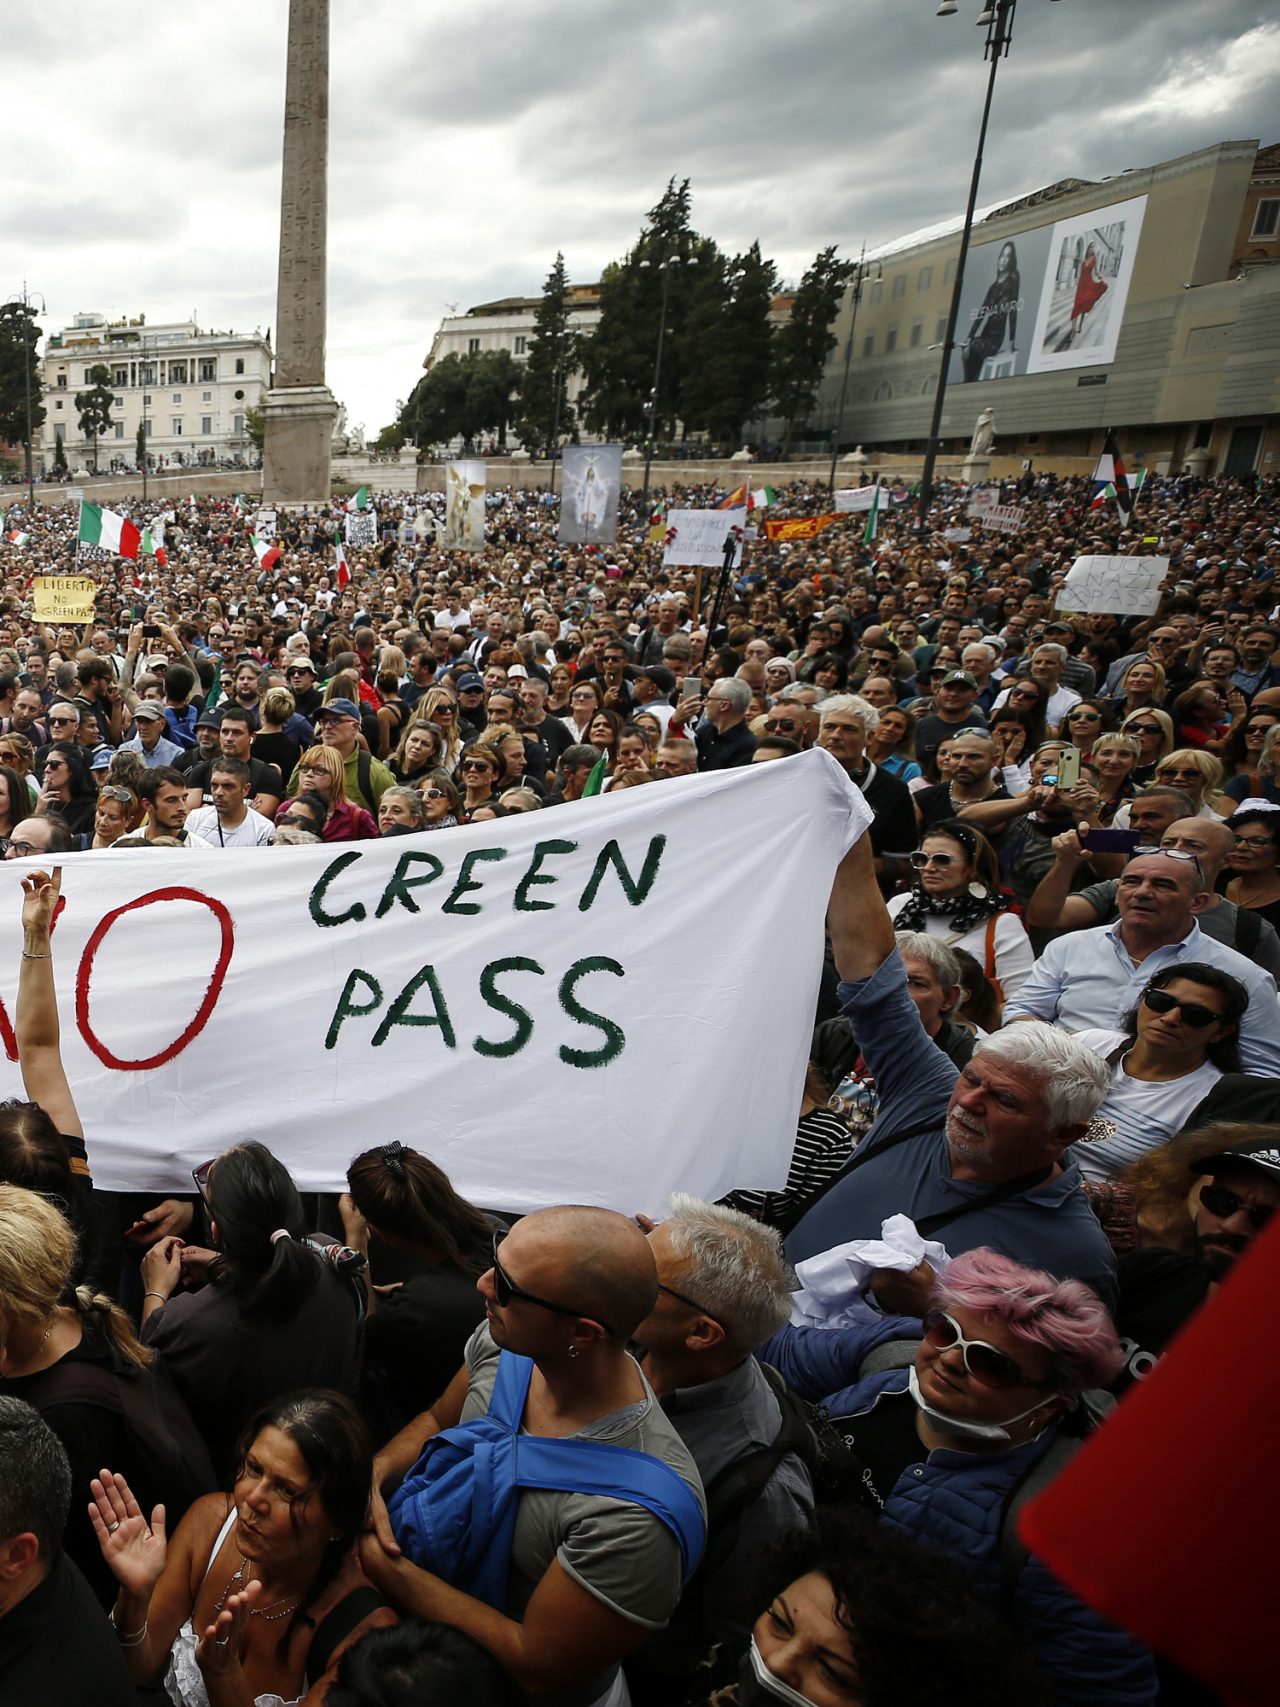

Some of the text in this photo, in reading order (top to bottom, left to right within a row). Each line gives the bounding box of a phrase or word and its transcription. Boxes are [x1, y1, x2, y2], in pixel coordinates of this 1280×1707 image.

[969, 304, 998, 320] ELENA
[1089, 556, 1152, 572] FUCK
[1086, 571, 1155, 590] NAZI
[53, 594, 67, 604] NO
[1090, 588, 1152, 607] PASS
[41, 606, 74, 616] GREEN
[307, 833, 667, 928] GREEN
[324, 955, 626, 1069] PASS
